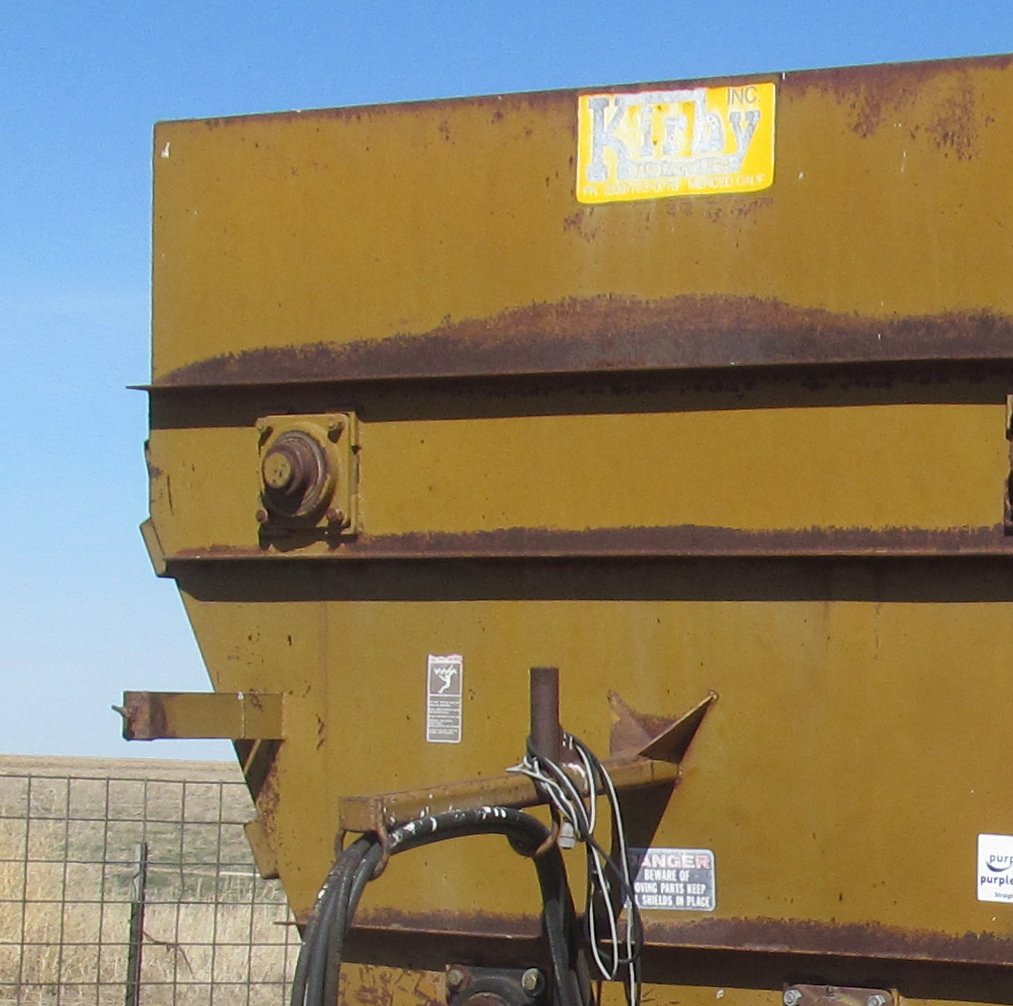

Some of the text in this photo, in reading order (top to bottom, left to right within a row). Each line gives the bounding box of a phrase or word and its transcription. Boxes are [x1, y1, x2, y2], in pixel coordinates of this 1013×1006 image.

[644, 869, 690, 882] BEWARE OF
[634, 882, 707, 895] OVING PARTS KEEP
[641, 894, 673, 906] SHIELDS
[686, 895, 710, 908] PLACE
